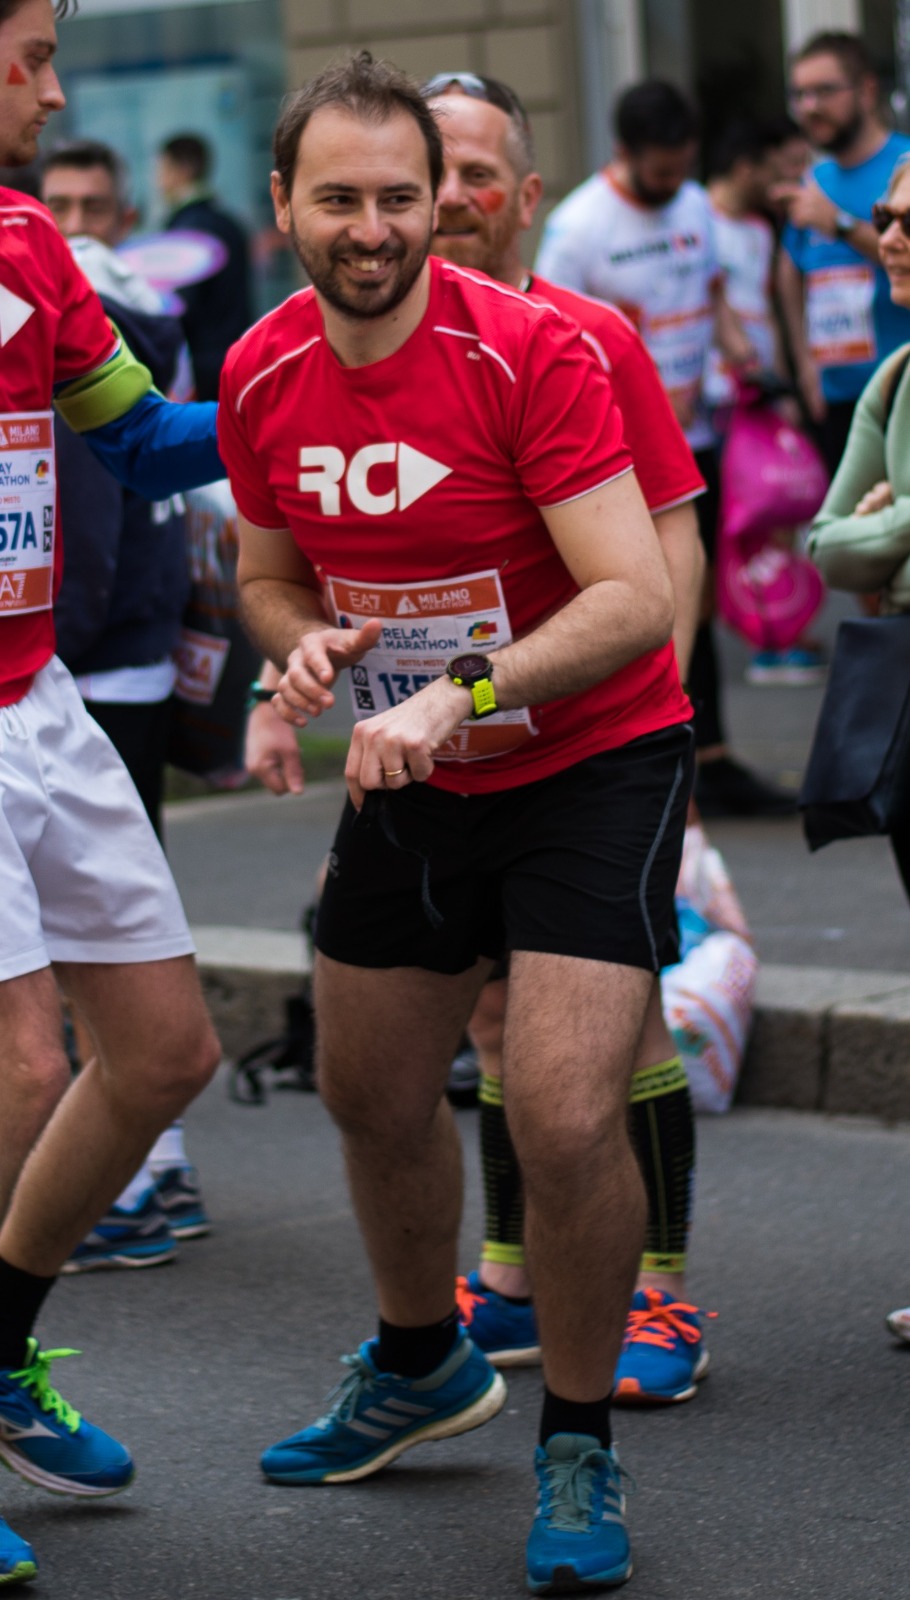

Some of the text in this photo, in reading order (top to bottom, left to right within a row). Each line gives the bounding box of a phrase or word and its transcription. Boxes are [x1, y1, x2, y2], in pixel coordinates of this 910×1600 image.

[349, 591, 382, 610] EA7
[418, 588, 470, 604] MILANO
[382, 627, 429, 640] RELAY
[386, 639, 458, 650] MARATHON
